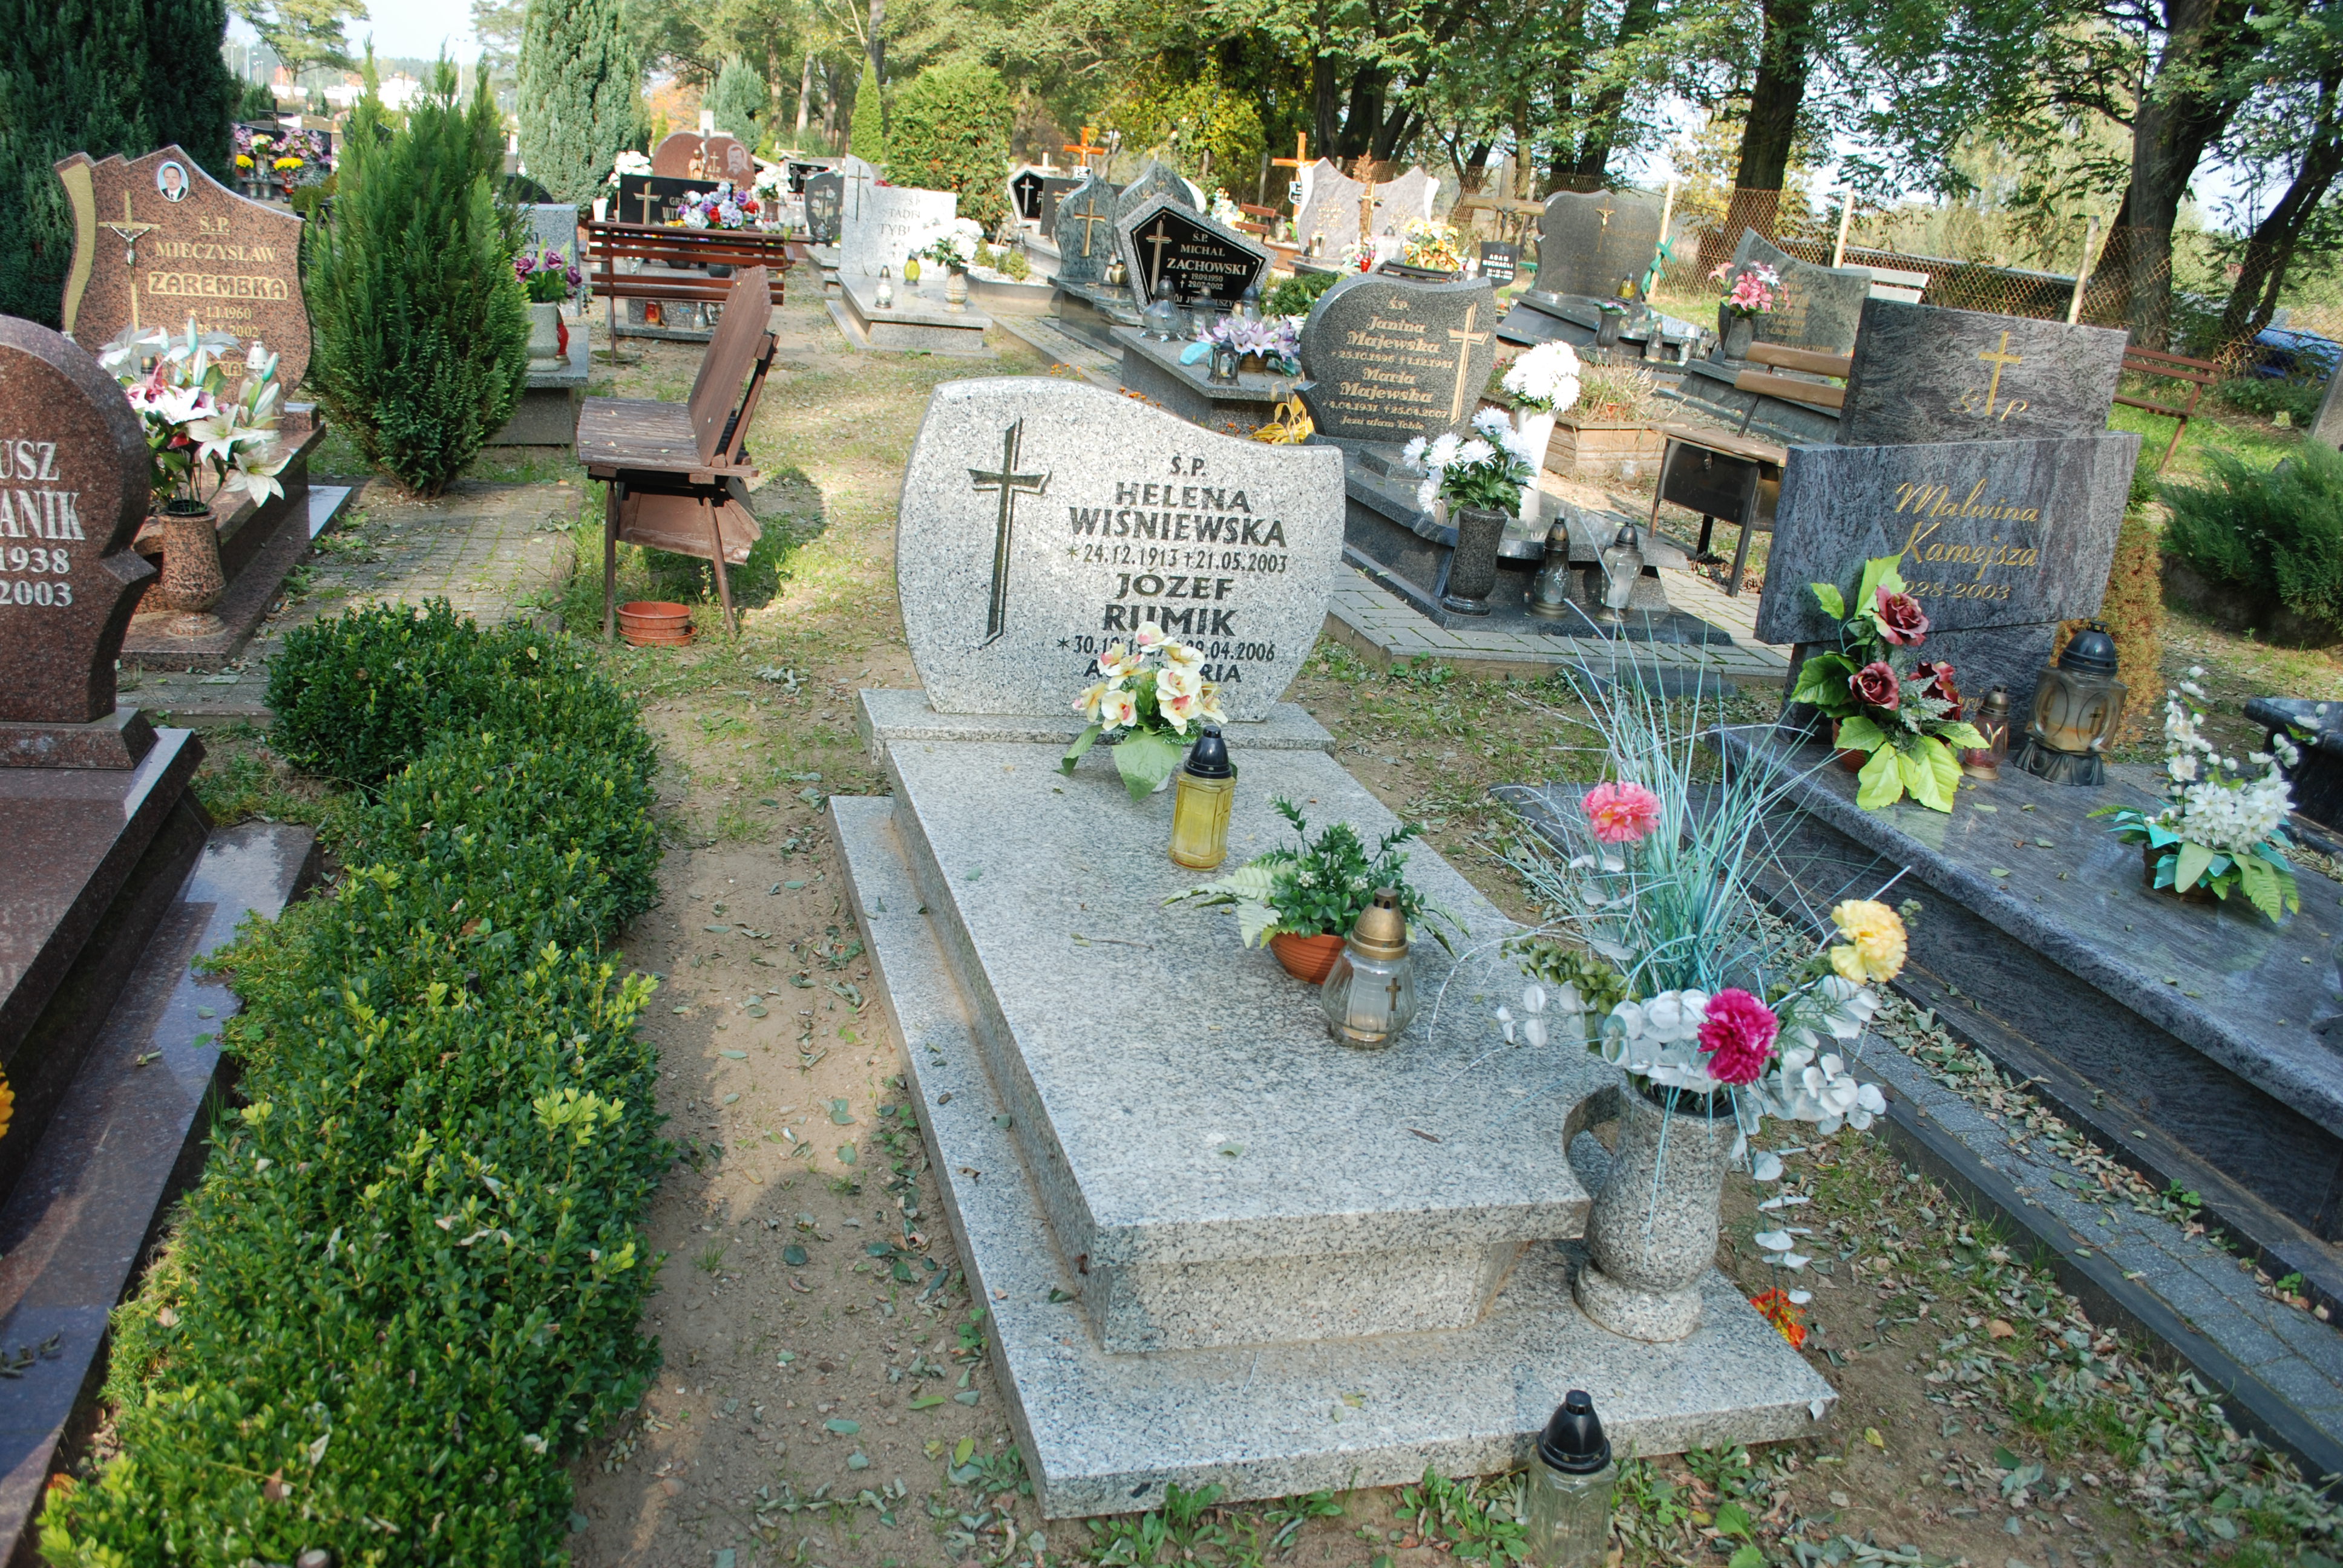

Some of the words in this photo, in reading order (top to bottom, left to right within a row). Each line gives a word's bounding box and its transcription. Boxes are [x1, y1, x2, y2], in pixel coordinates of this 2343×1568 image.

[1167, 257, 1247, 275] ZACHOWSKI
[1489, 253, 1509, 262] ADAM
[149, 272, 289, 300] ZAREMBKA
[1366, 314, 1427, 333] Janina
[1346, 330, 1441, 353] Majewska
[1362, 367, 1416, 384] Maria
[1339, 381, 1434, 403] Majewska
[1340, 415, 1365, 425] Jezu
[1366, 418, 1394, 428] ufam
[1397, 419, 1425, 430] Tobie
[1115, 482, 1253, 513] HELENA
[1895, 478, 2040, 522] Malwina
[1900, 521, 2039, 581] Kamejsza
[1102, 604, 1239, 636] RUMIK
